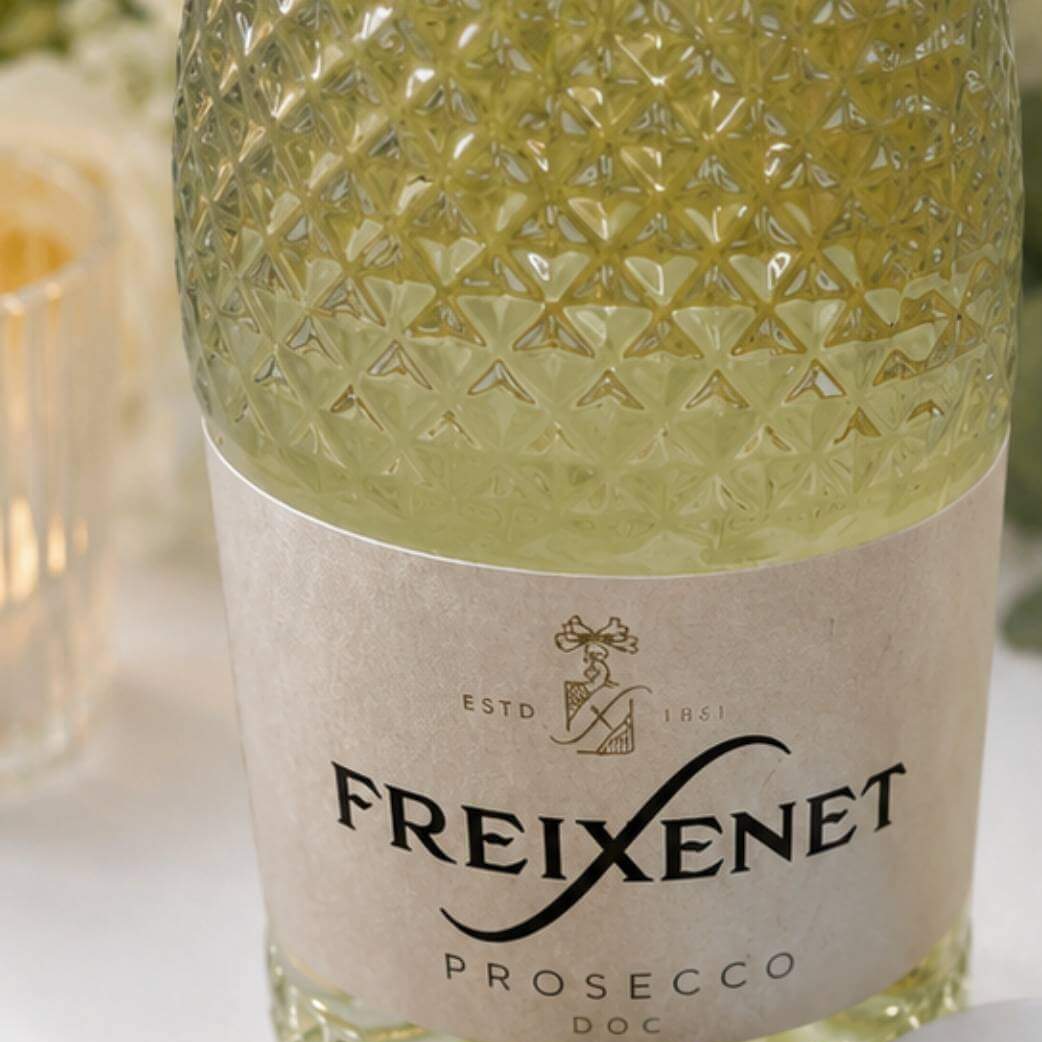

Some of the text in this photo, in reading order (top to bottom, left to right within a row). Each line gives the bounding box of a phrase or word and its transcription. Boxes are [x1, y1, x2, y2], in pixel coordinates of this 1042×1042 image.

[462, 694, 535, 720] ESTD
[332, 734, 907, 944] FREIXENET
[444, 951, 796, 1001] PROSECCO
[572, 1016, 662, 1036] DOC
